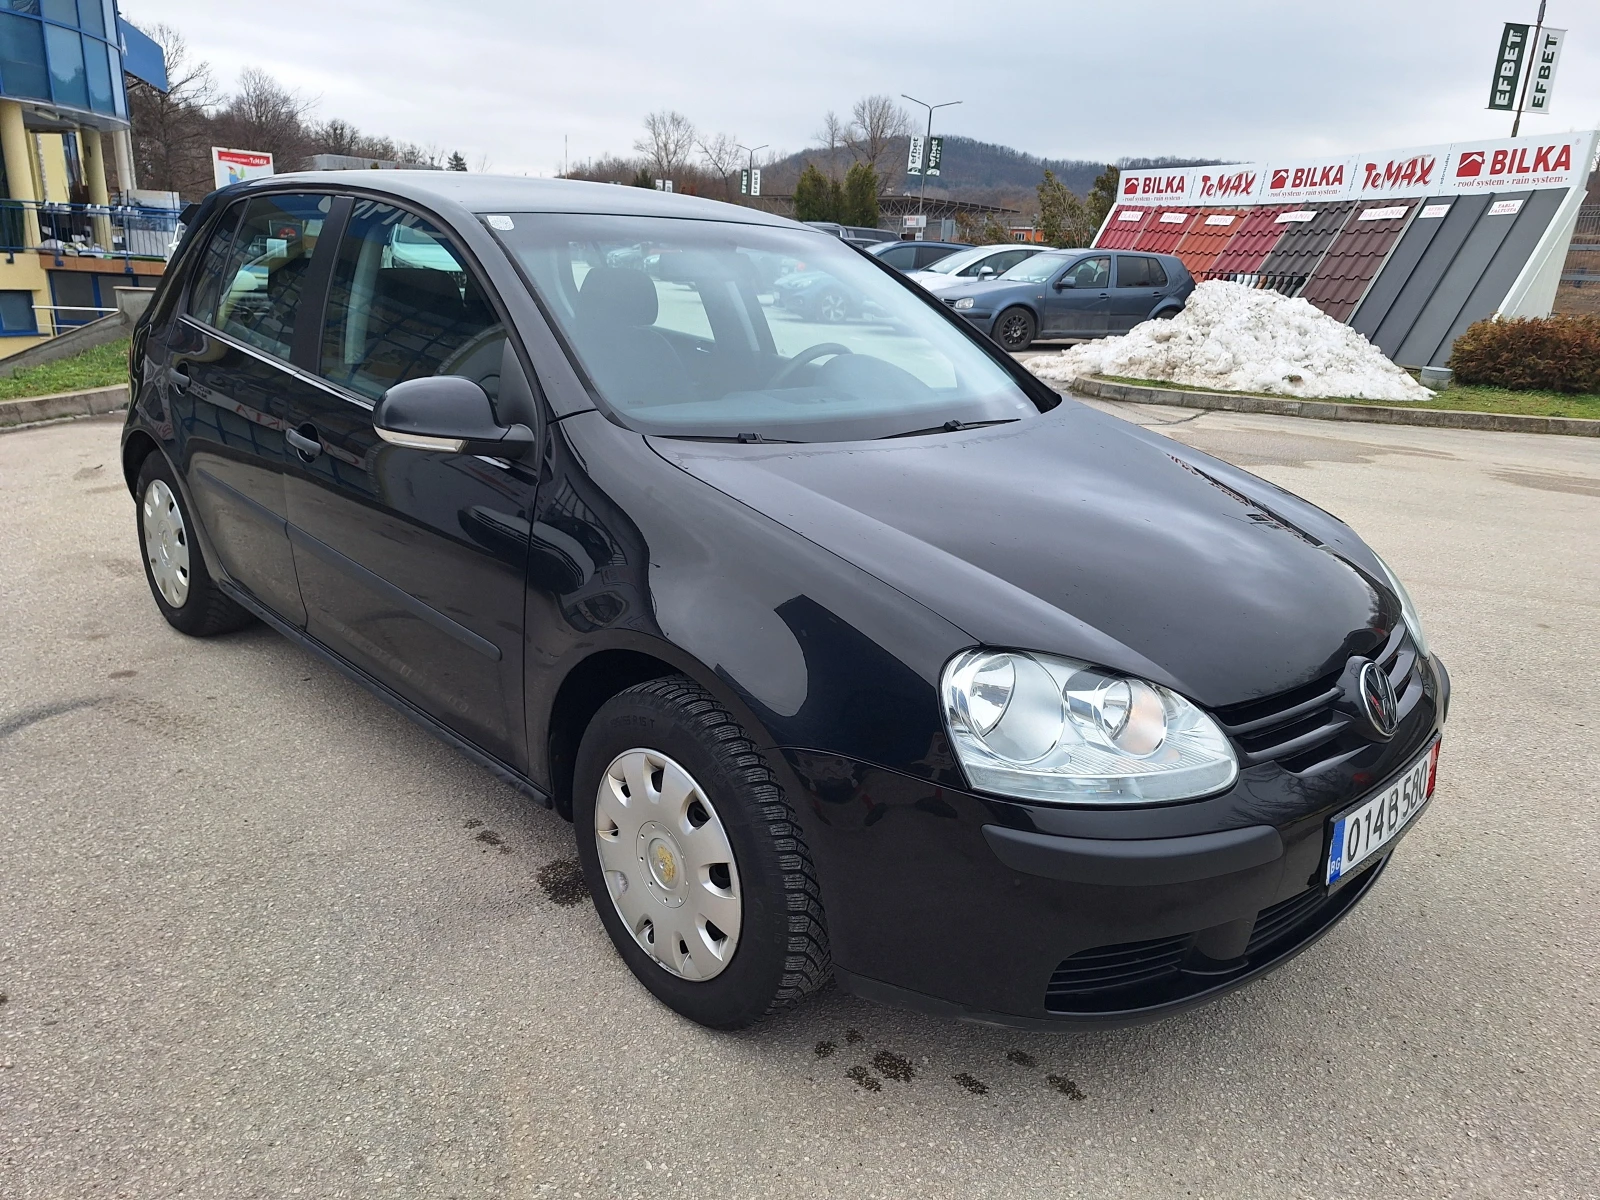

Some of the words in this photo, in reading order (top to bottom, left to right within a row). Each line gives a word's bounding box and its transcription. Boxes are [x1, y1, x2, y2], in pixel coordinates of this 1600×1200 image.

[1495, 29, 1522, 106] EFBET
[1532, 33, 1558, 108] EFBET
[910, 137, 919, 164] efbet
[929, 139, 938, 167] efbet
[1489, 144, 1571, 175] BILKA
[1142, 175, 1185, 194] BILKA
[1291, 165, 1344, 188] BILKA
[1457, 178, 1477, 188] roof
[1477, 179, 1505, 188] system
[1511, 175, 1530, 185] rain
[1531, 176, 1564, 185] system
[1281, 190, 1301, 198] system
[1305, 188, 1317, 196] rain
[1318, 189, 1338, 197] system
[1330, 857, 1341, 873] BG
